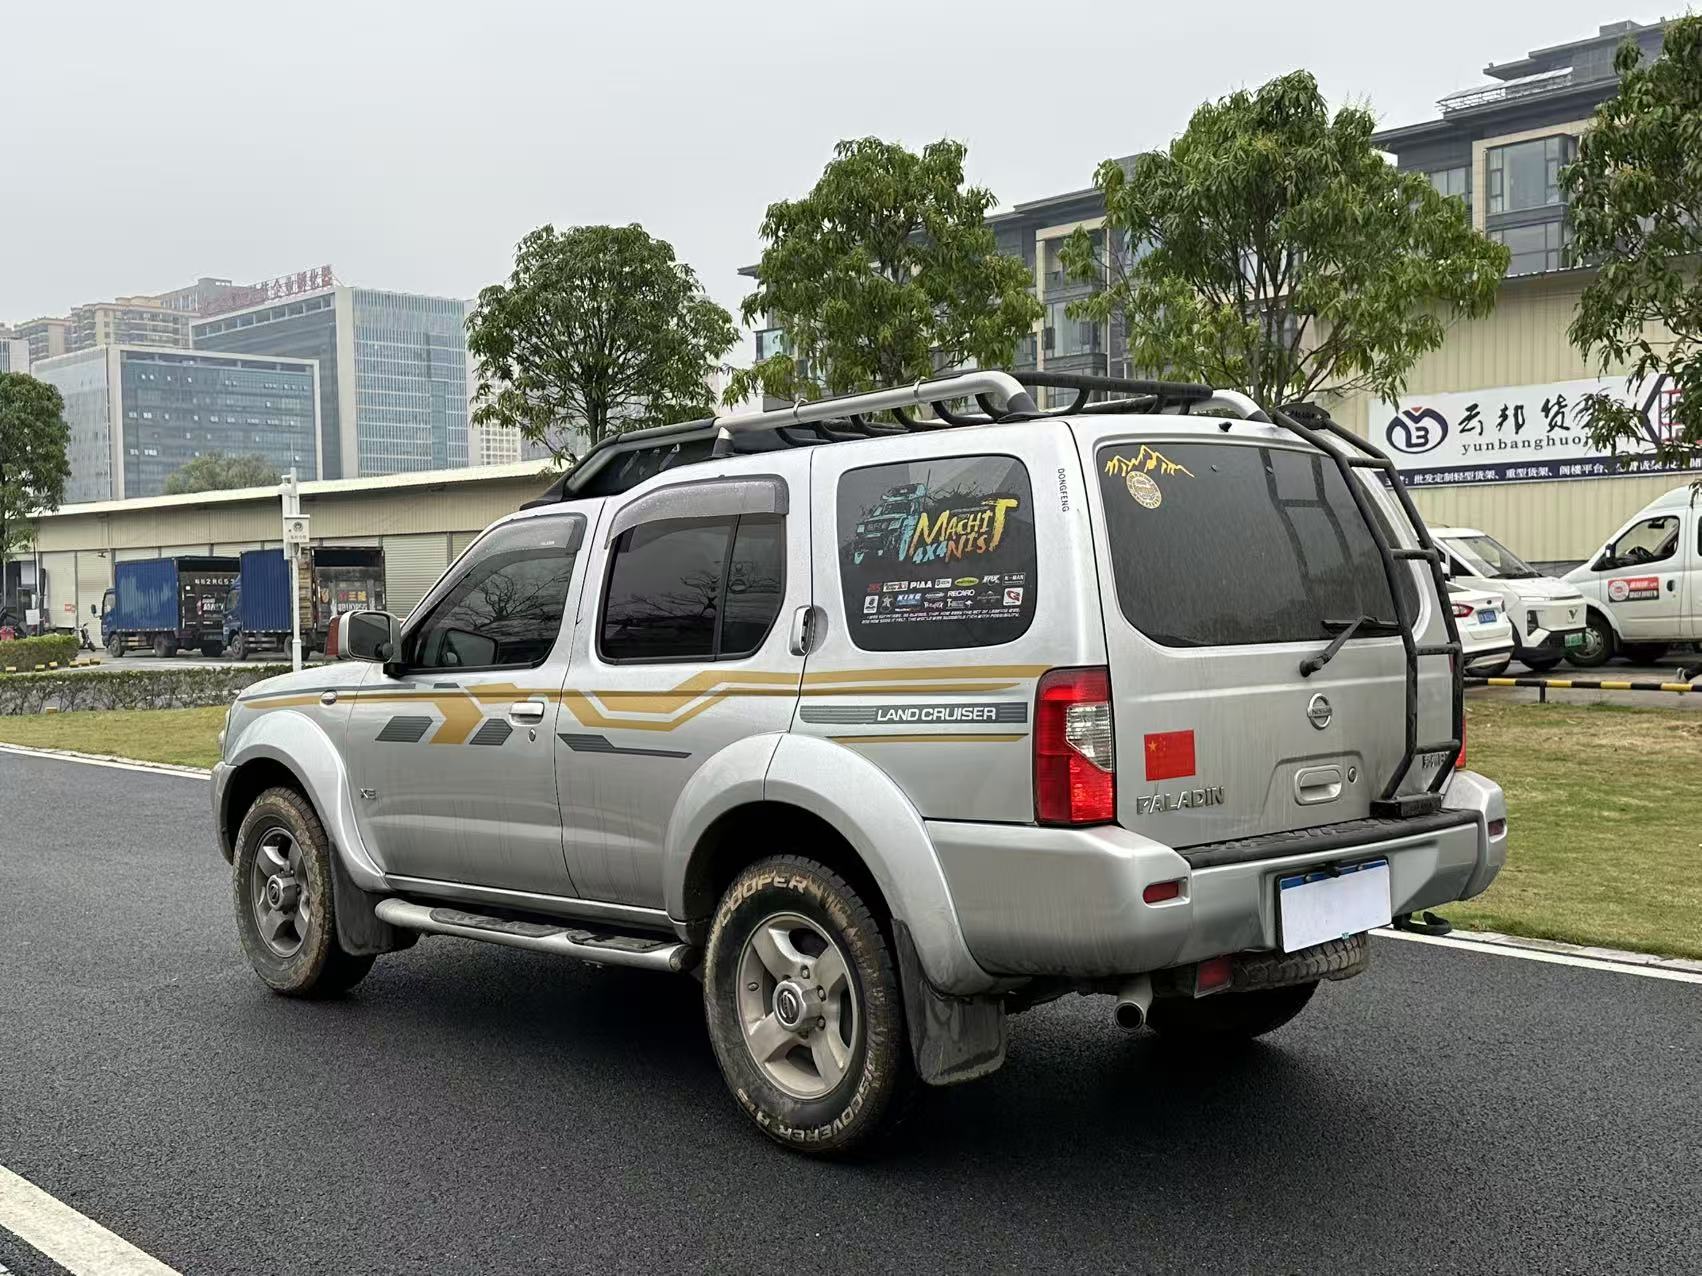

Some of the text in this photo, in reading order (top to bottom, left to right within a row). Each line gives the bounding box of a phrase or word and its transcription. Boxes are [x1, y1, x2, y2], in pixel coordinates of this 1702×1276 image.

[1457, 394, 1600, 437] 云邦货
[1057, 468, 1070, 512] DONGFENG
[909, 580, 932, 589] PIAA
[876, 707, 997, 721] LAND CRUISER
[1136, 786, 1225, 815] PALADIN
[722, 873, 808, 927] COOPER
